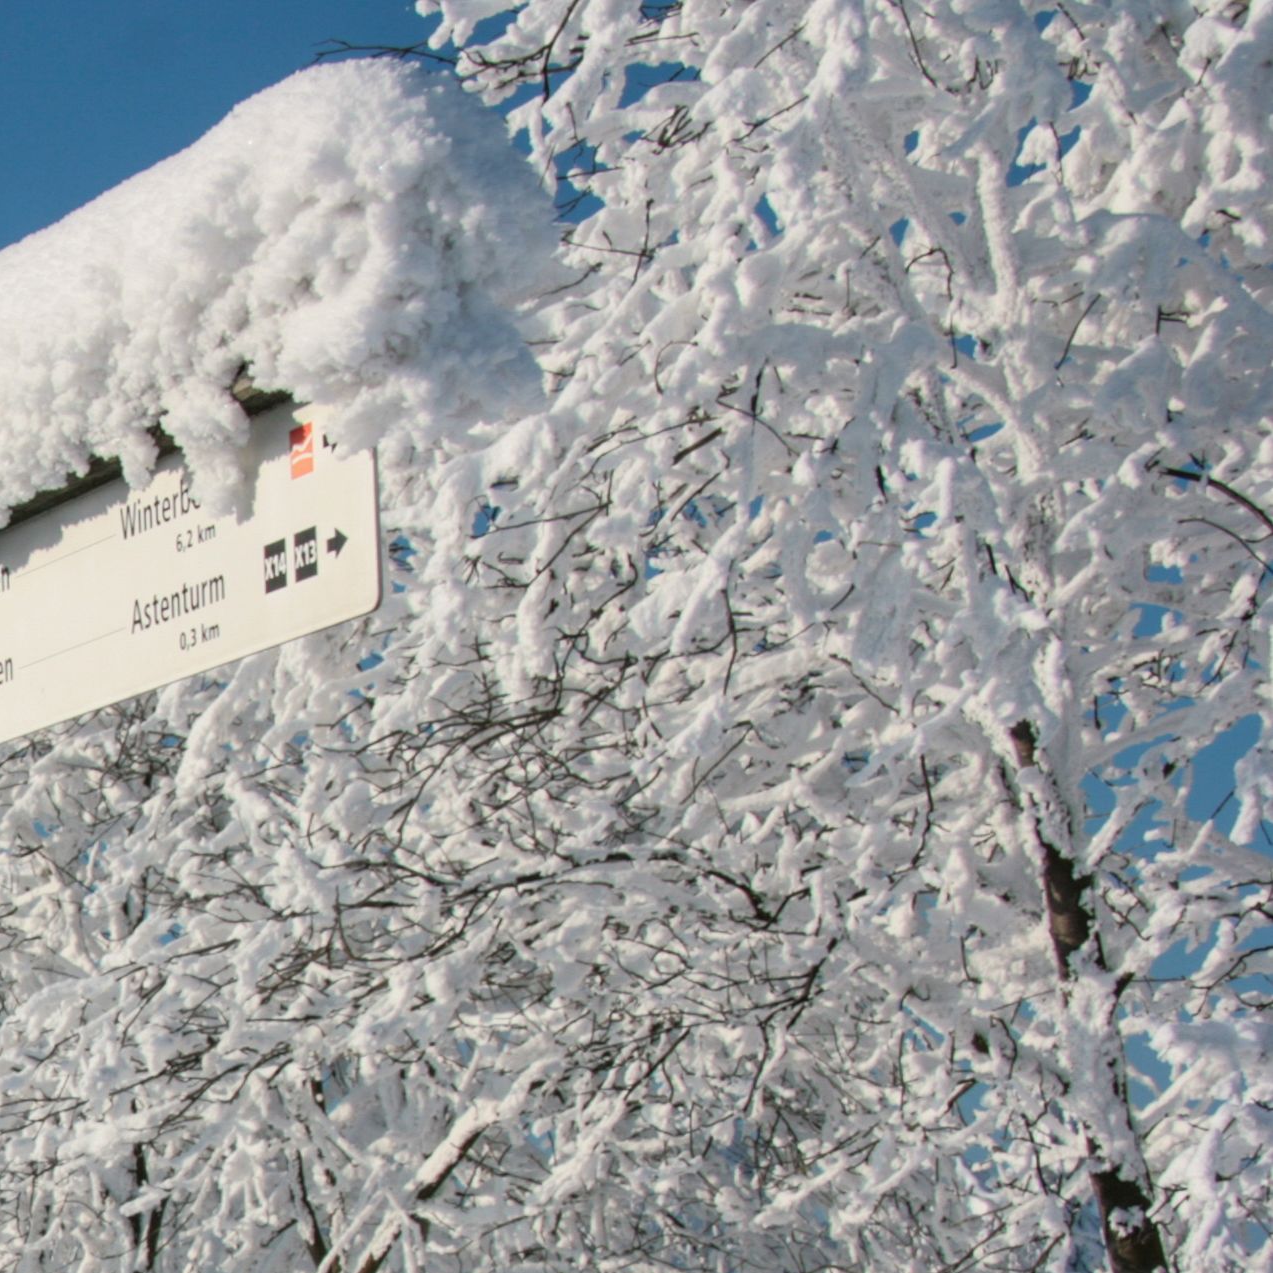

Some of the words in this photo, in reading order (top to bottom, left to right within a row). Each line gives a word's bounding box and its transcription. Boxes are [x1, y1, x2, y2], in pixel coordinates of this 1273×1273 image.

[176, 530, 193, 552] 6,2
[197, 523, 216, 545] km
[264, 553, 286, 580] X14
[294, 540, 316, 569] X13
[131, 573, 225, 634] Astenturm
[179, 628, 197, 651] 0,3
[201, 623, 220, 642] km
